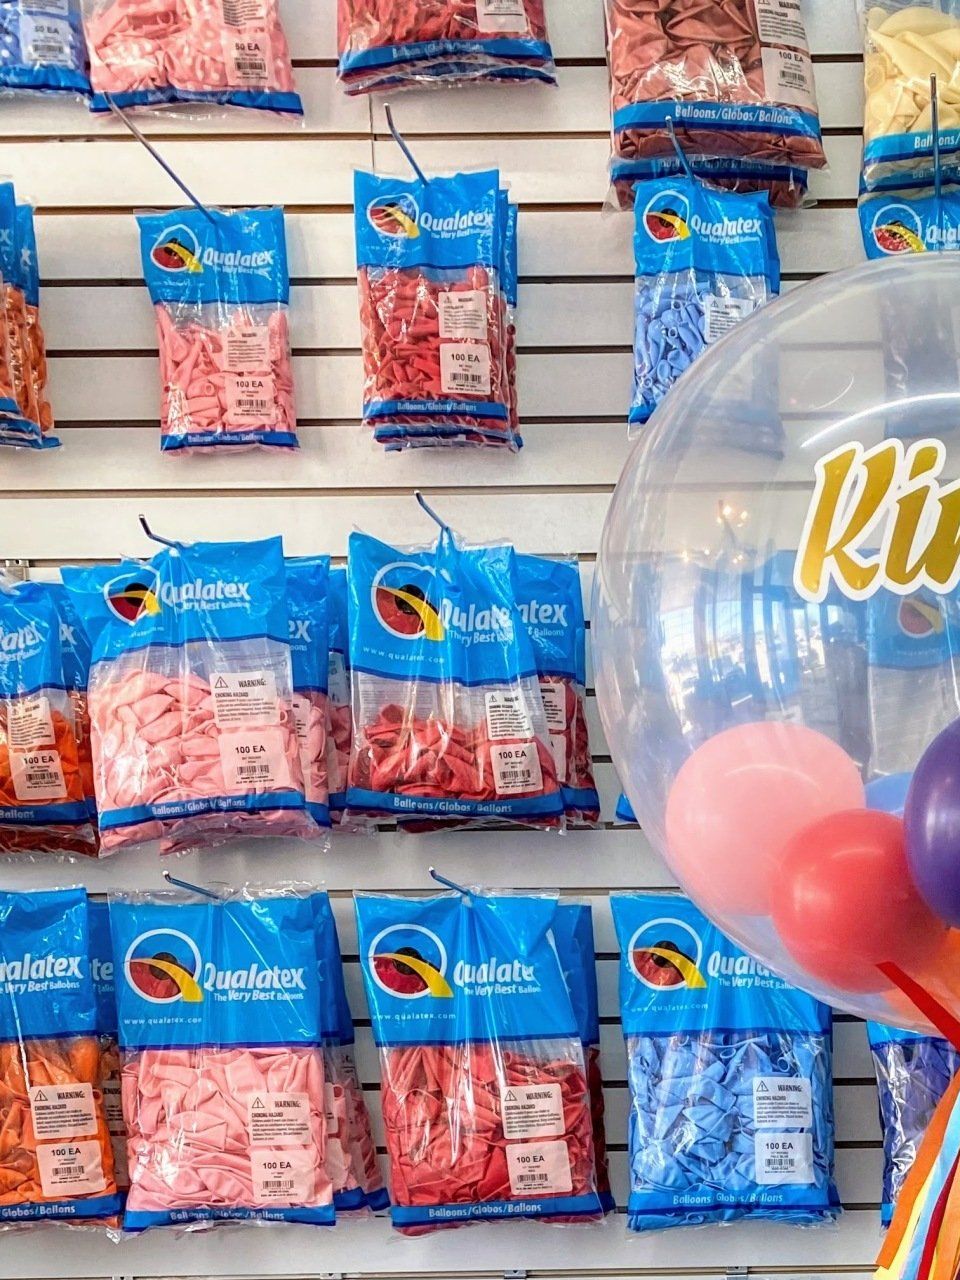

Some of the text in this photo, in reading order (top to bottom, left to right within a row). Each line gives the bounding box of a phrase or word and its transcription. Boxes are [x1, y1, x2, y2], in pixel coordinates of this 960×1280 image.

[778, 51, 804, 64] 100 EA
[675, 104, 794, 125] Balloons/Globos/Ballons
[420, 211, 494, 232] Qualatex
[691, 215, 762, 237] Qualatex
[202, 246, 273, 268] Qualatex
[450, 353, 481, 363] 100 EA
[235, 380, 264, 389] 100 EA
[235, 744, 266, 754] 100 EA
[498, 749, 528, 760] 100 EA
[203, 962, 307, 992] Qualatex
[213, 992, 227, 1002] The
[228, 990, 251, 1003] Very
[252, 989, 276, 1001] Best
[51, 1147, 81, 1157] 100 EA
[765, 1142, 794, 1150] 100 EA
[516, 1154, 546, 1164] 100 EA
[262, 1161, 292, 1170] 100 EA
[428, 1203, 542, 1218] Balloons/Globos/Ballons
